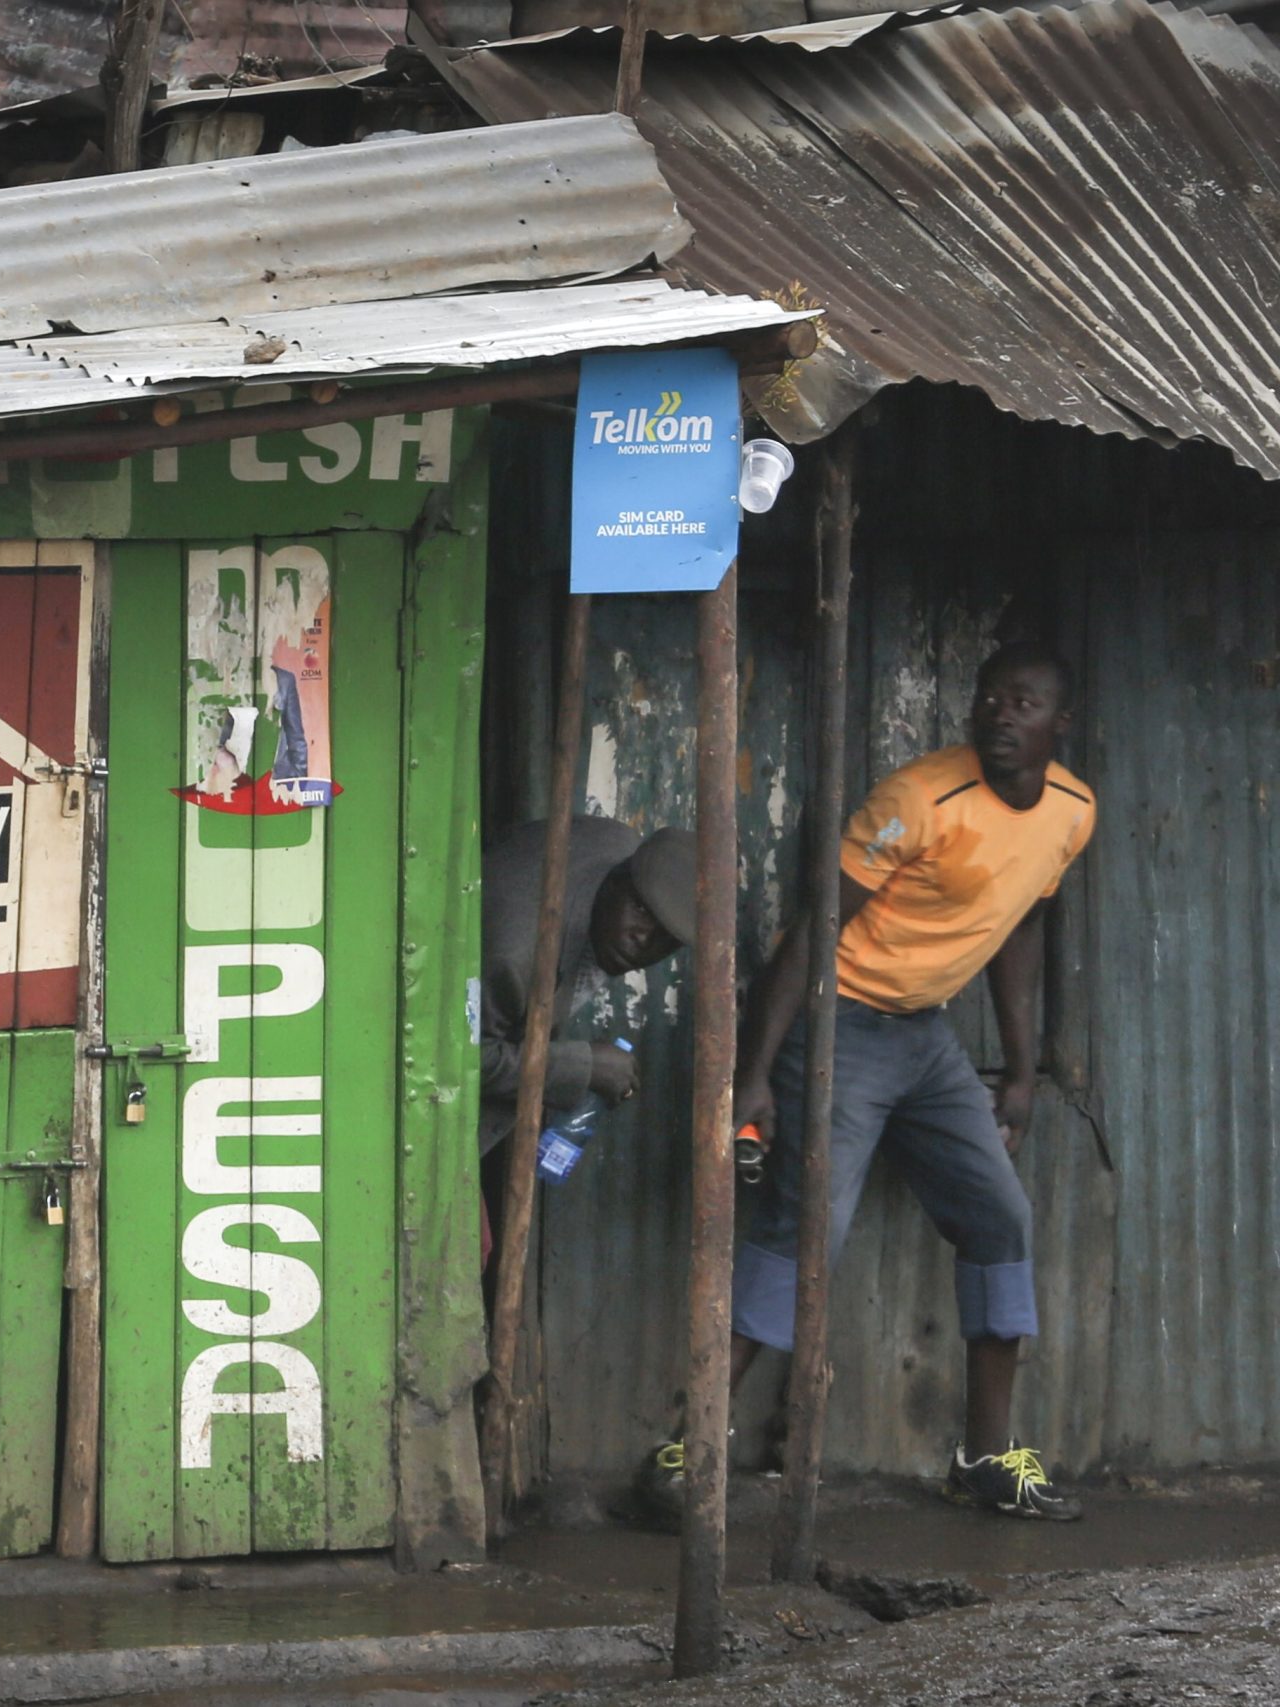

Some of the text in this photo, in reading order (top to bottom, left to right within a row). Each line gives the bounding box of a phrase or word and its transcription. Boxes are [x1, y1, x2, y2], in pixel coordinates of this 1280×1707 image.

[590, 408, 713, 444] Telkom
[618, 443, 711, 455] MOVING WITH YOU
[619, 510, 684, 523] SIM CARD
[596, 522, 706, 536] AVAILABLE HERE
[181, 943, 325, 1469] PESA
